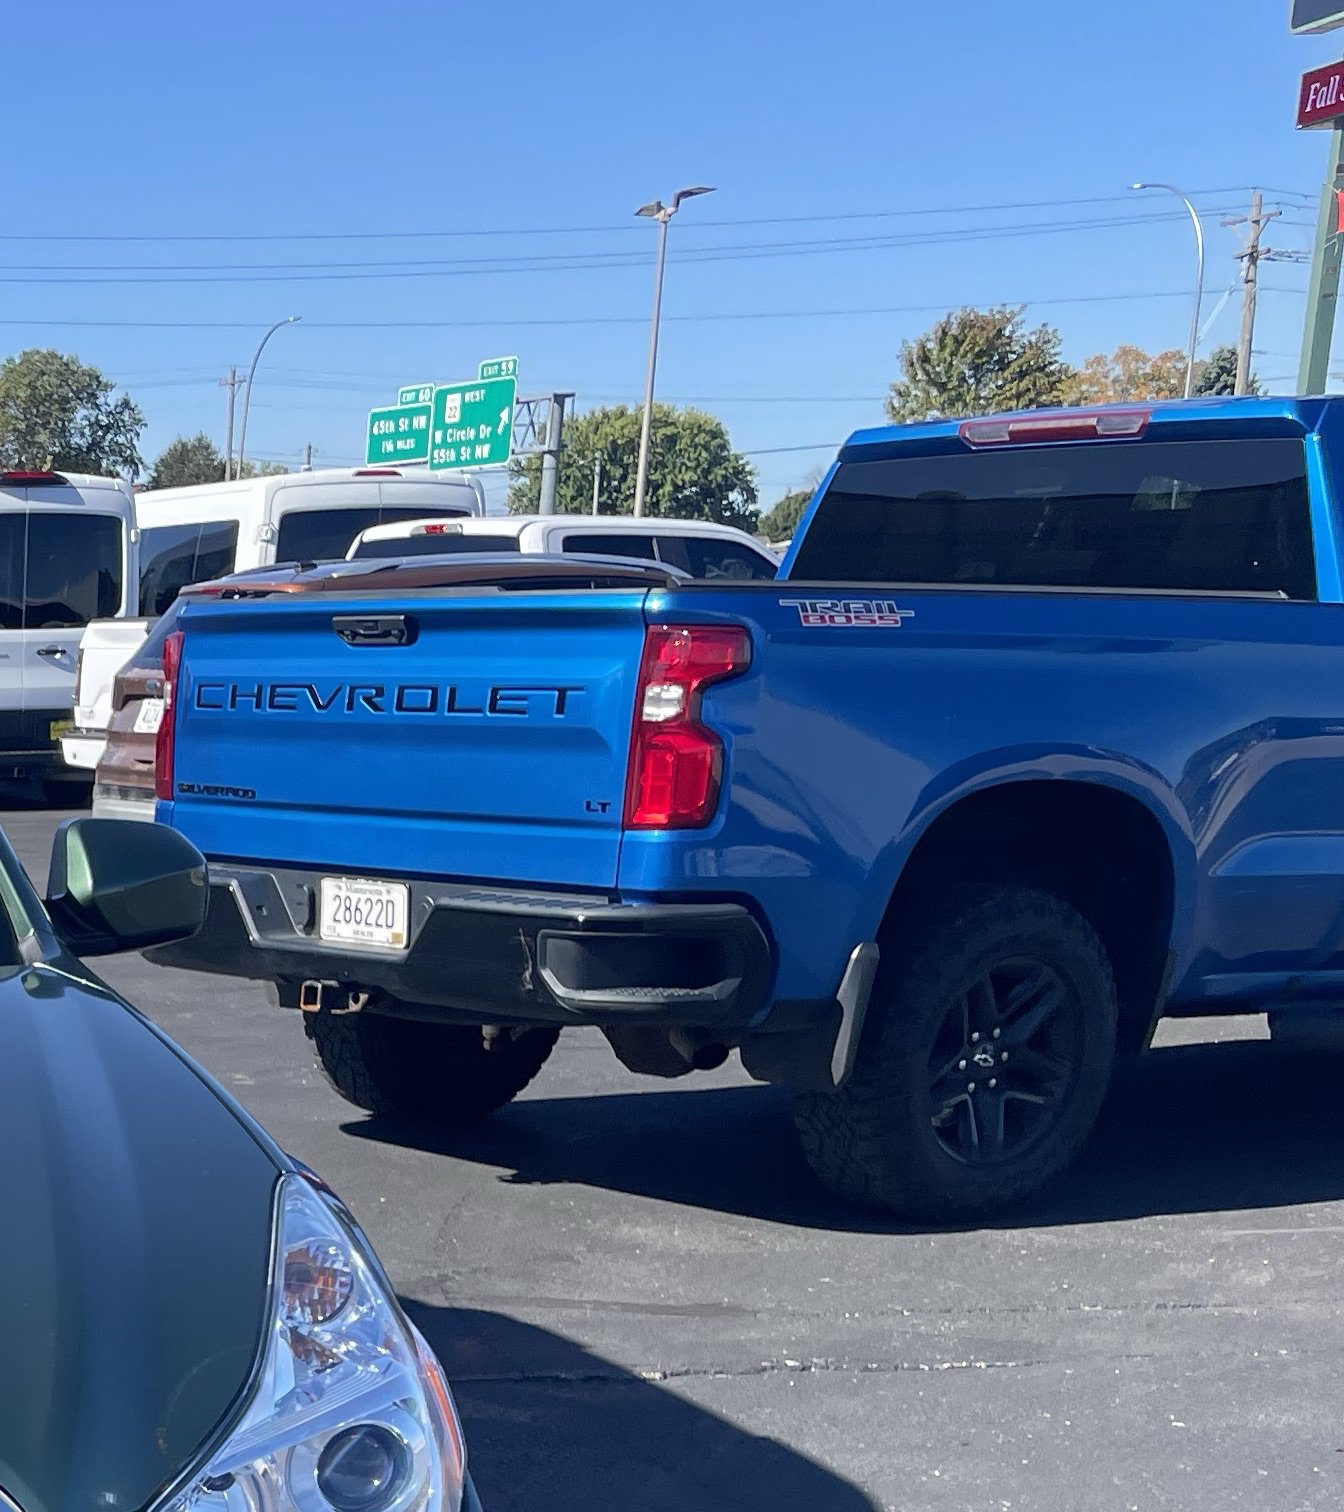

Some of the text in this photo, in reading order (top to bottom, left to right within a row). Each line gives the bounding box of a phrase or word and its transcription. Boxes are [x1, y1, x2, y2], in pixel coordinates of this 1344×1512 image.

[1304, 75, 1339, 112] Fall
[483, 360, 514, 377] EXIT 59
[418, 387, 431, 402] 60
[464, 389, 486, 403] WEST
[447, 405, 457, 419] 22
[372, 415, 427, 436] 65th St NW
[434, 424, 492, 445] W Circle Dr
[397, 438, 416, 450] MILES
[432, 443, 491, 464] 55th St NW
[779, 599, 915, 617] TRAIL
[802, 614, 901, 627] BOSS
[194, 683, 586, 718] CHEVROLET
[585, 800, 611, 813] LT
